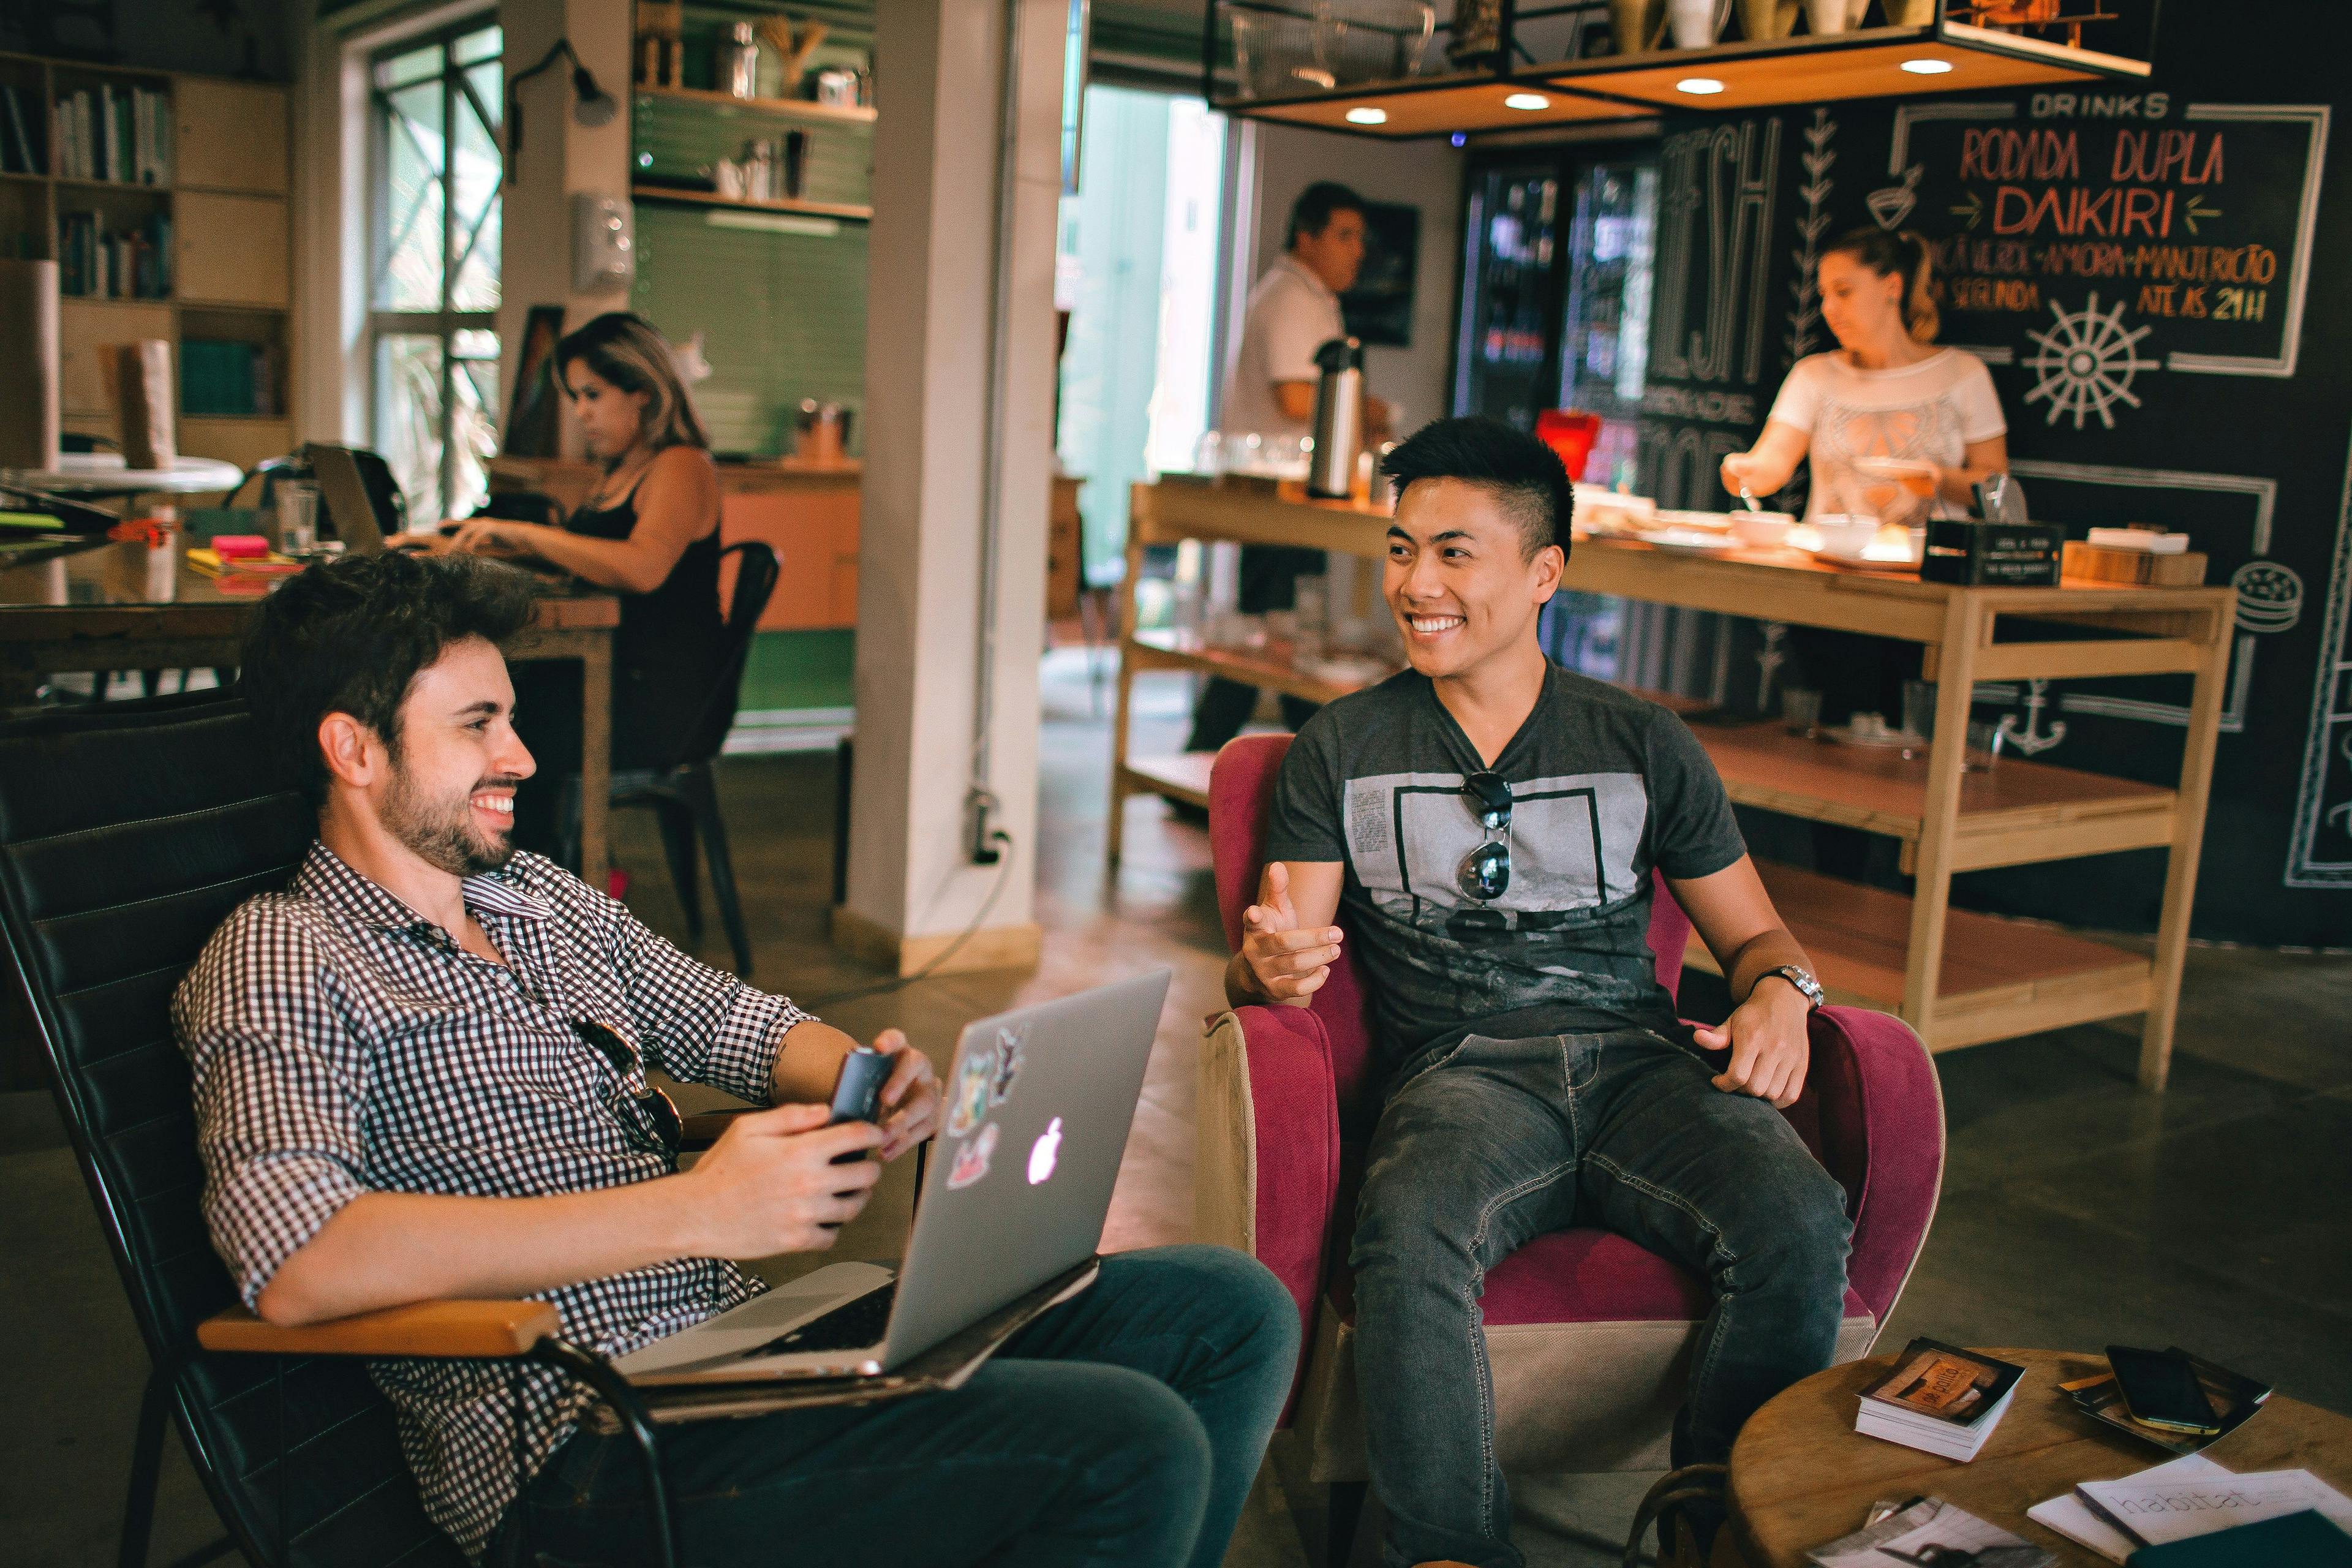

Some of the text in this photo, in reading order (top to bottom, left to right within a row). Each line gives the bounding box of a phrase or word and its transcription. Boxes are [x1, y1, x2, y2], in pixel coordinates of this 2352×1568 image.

[2030, 92, 2170, 119] DRINKS
[1959, 127, 2224, 184] RODADA DUPLA
[1992, 184, 2175, 238] DAIKIRI
[2109, 1489, 2261, 1515] habitat
